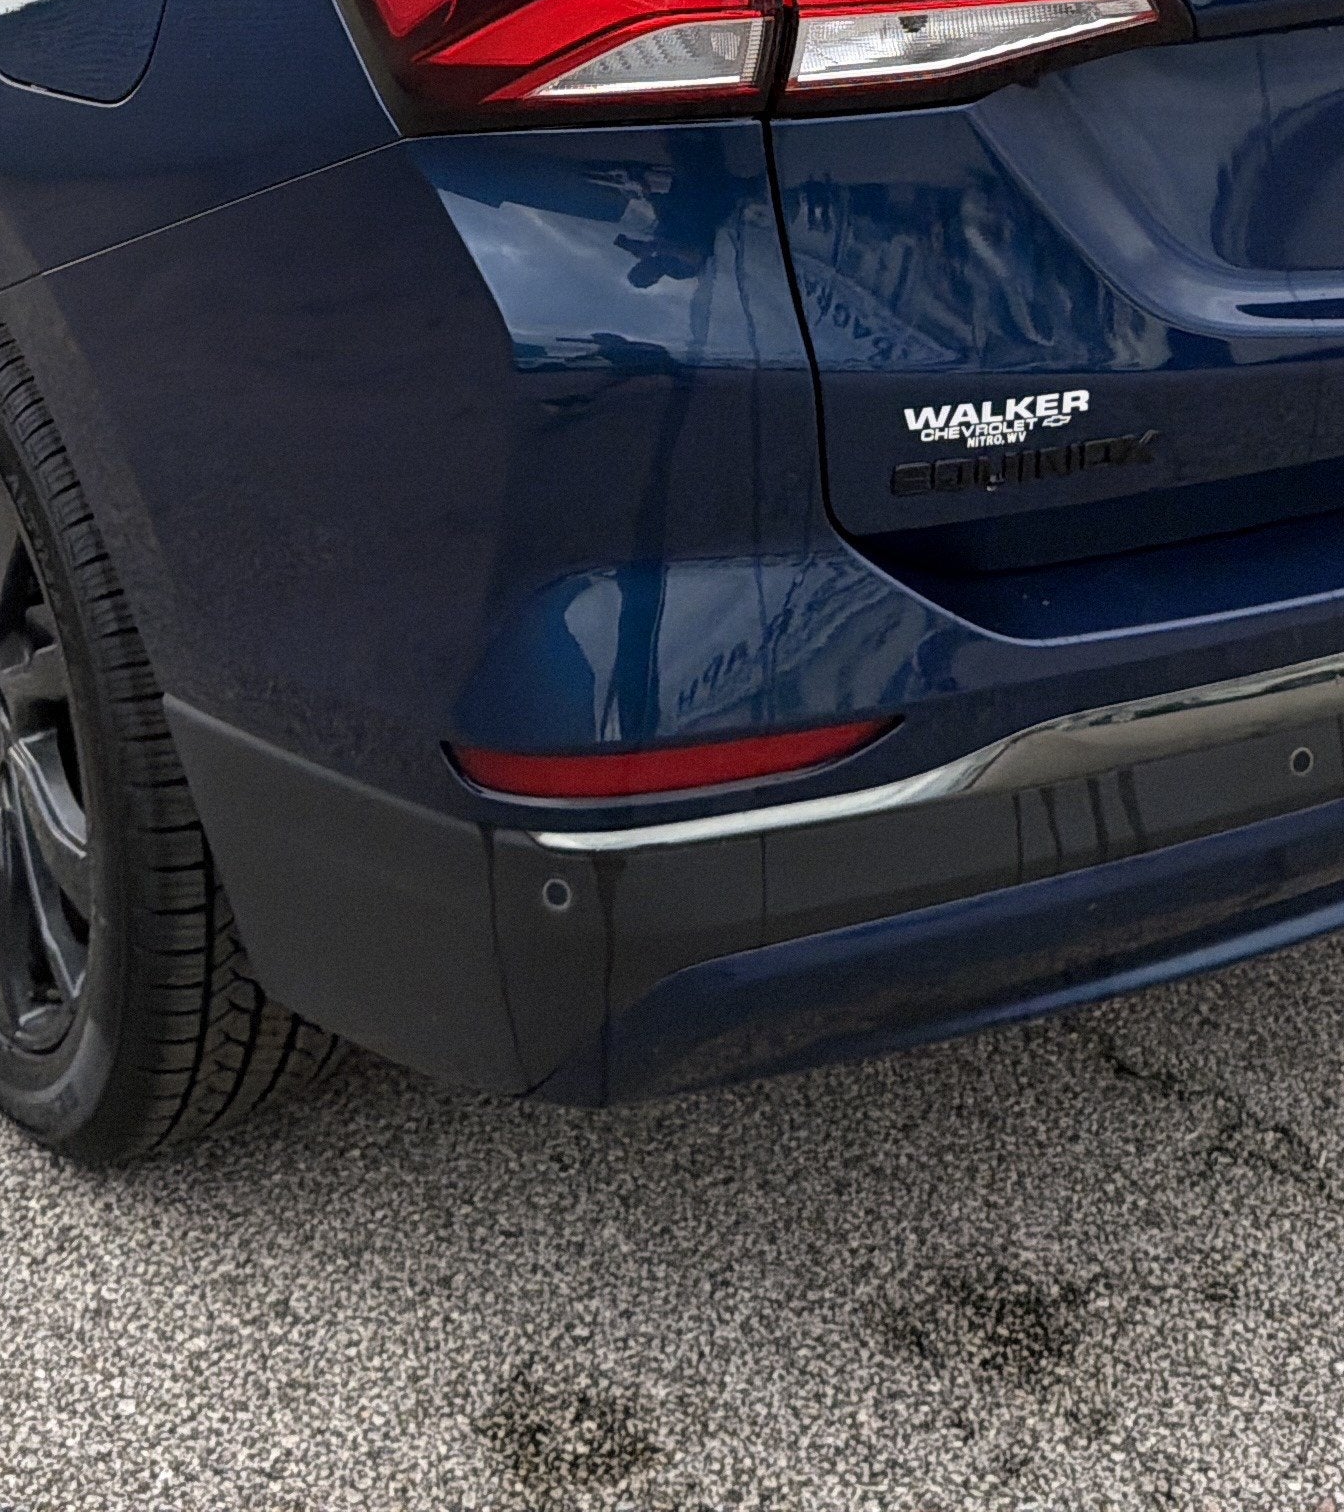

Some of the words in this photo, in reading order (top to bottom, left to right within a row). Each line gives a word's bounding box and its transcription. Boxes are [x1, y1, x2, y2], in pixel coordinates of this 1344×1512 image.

[904, 389, 1090, 431] WALKER
[921, 417, 1039, 442] CHEVROLET
[1007, 430, 1027, 444] WV
